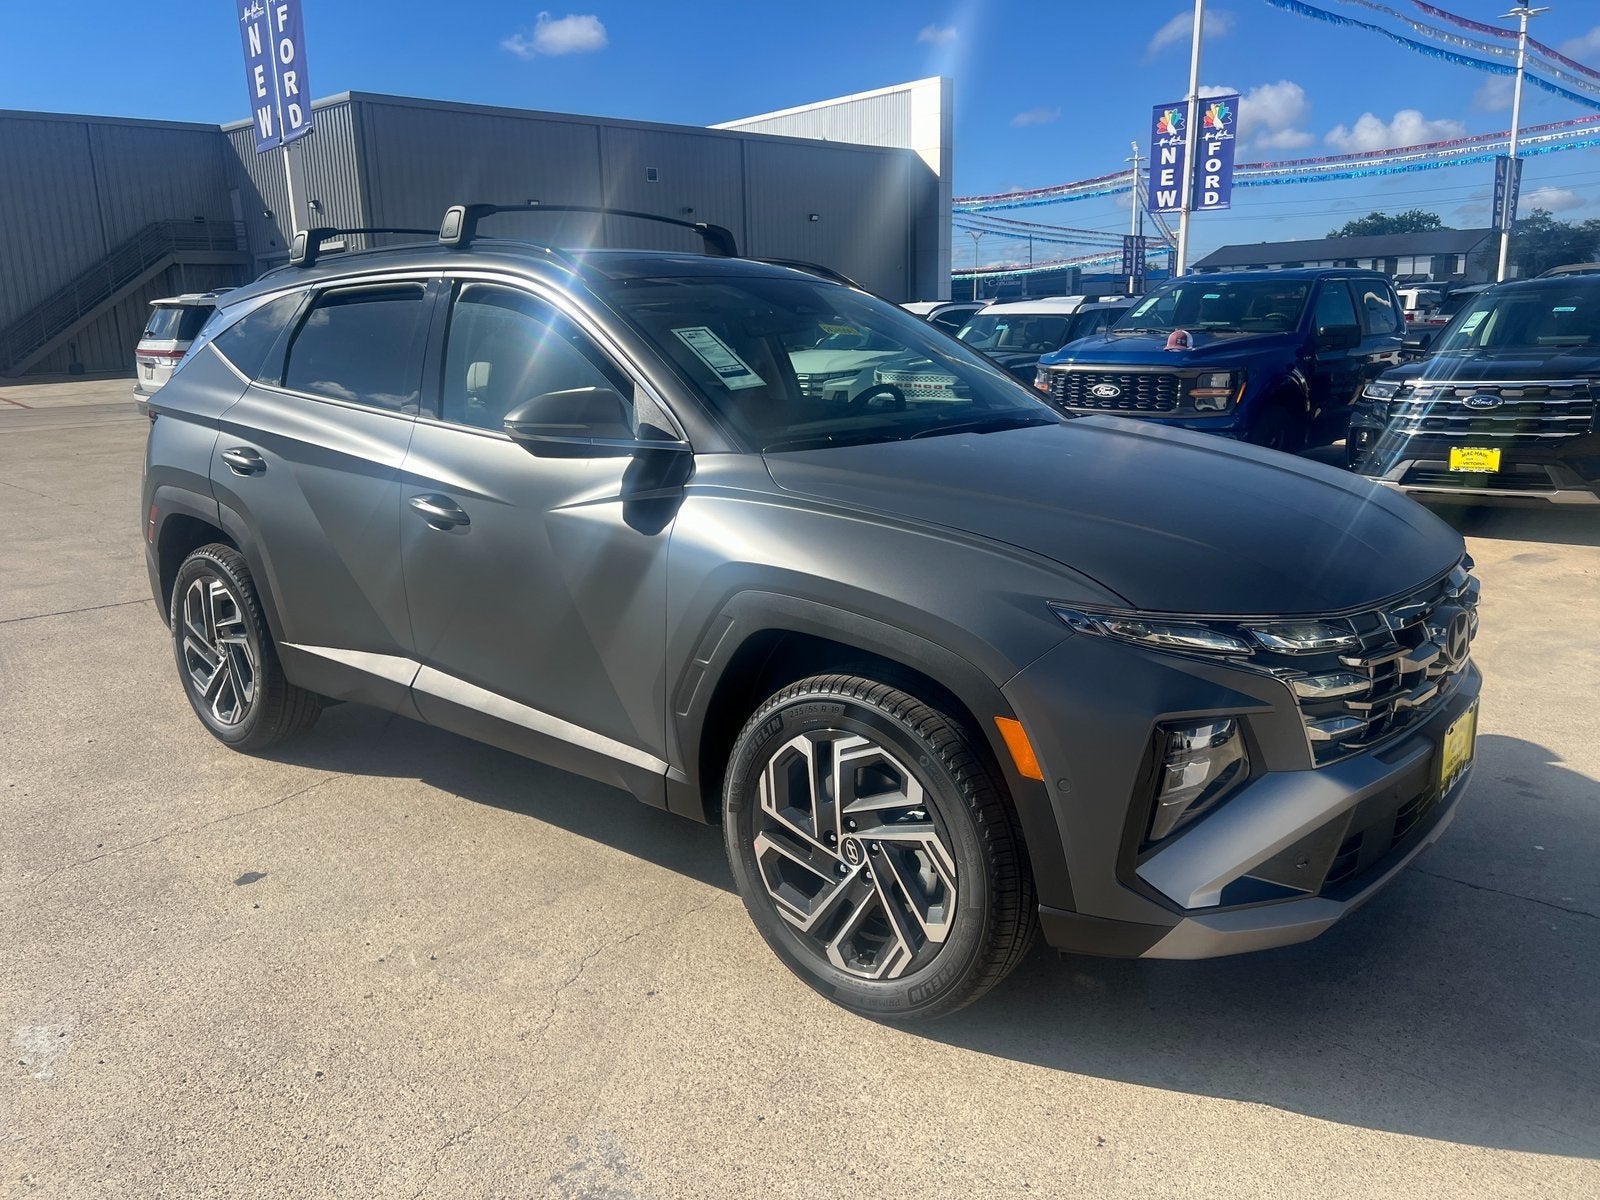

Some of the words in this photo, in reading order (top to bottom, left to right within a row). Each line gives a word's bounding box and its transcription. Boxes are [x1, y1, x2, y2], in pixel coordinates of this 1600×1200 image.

[247, 22, 273, 139] NEW
[276, 4, 303, 130] FORD
[1156, 146, 1177, 208] NEW
[1204, 141, 1222, 205] FORD
[1494, 185, 1503, 227] NEW
[1124, 251, 1132, 275] NEW
